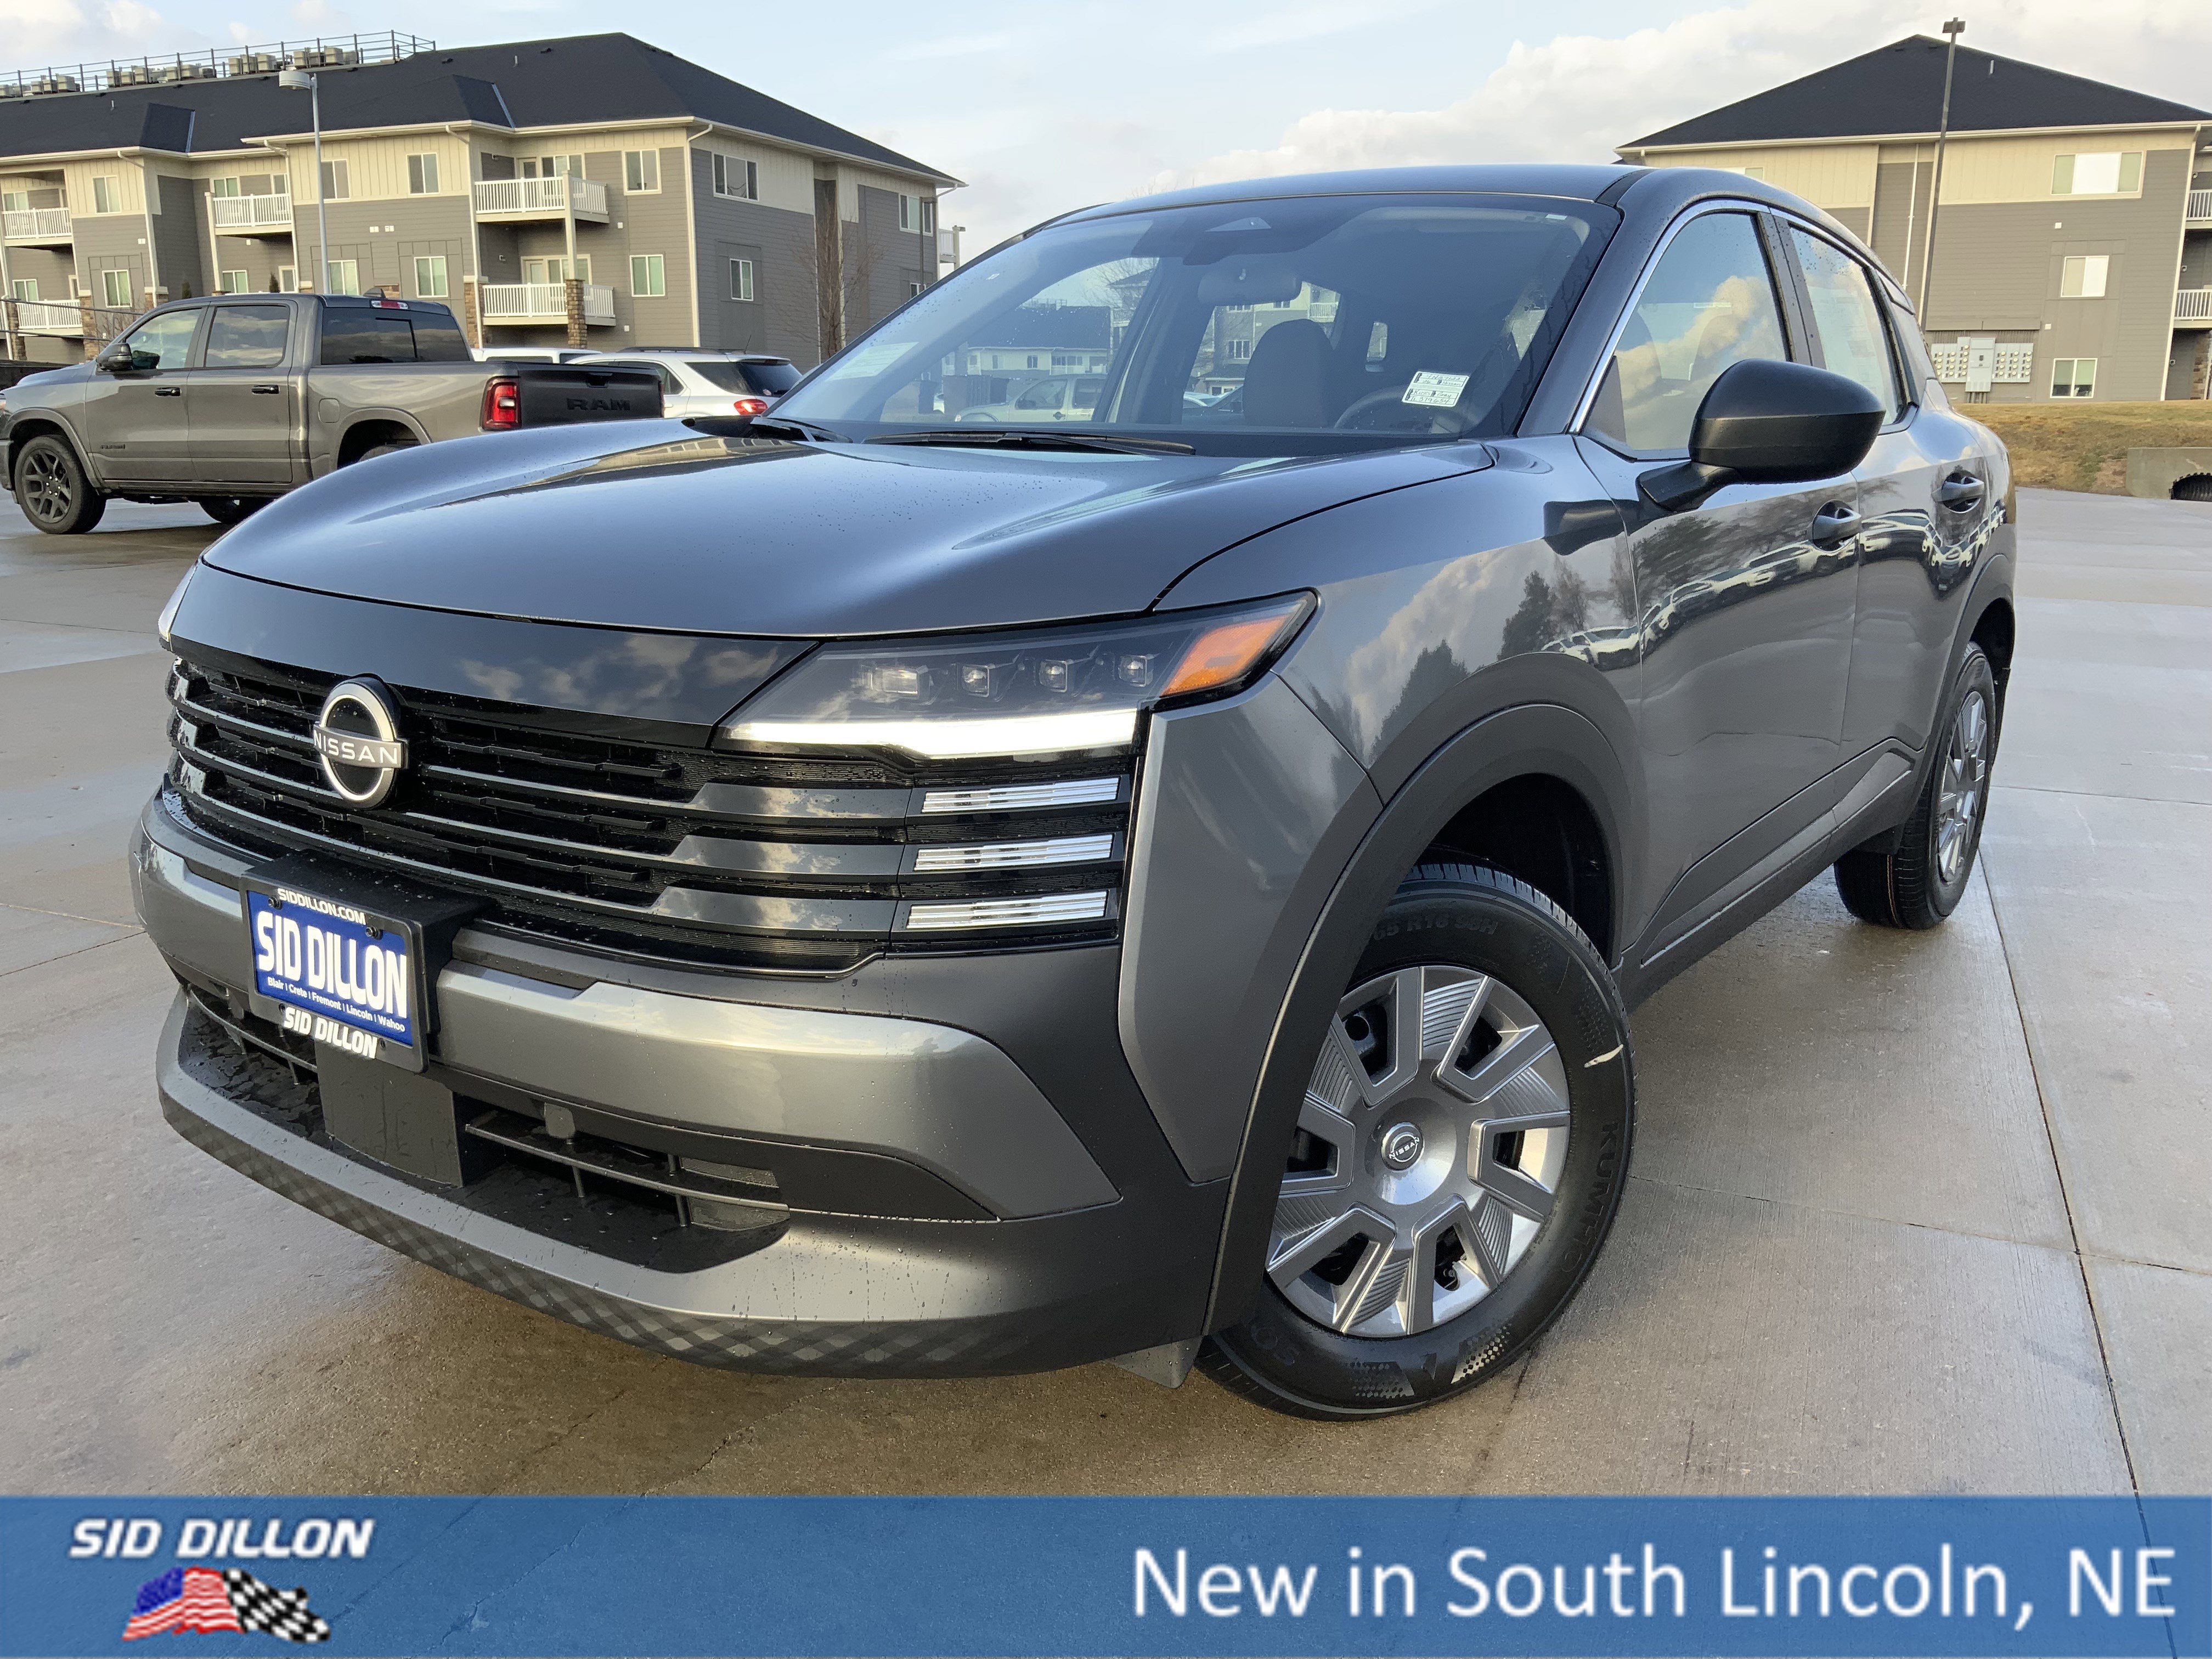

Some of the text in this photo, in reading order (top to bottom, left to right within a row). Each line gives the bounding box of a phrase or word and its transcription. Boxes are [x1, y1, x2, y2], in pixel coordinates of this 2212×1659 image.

[567, 398, 630, 410] RAM
[314, 730, 398, 764] NISSAN
[277, 888, 366, 926] SIDDILLON.COM
[257, 911, 407, 1019] SID DILLON
[267, 977, 405, 1032] Blair Crete Fremont Lincoln Wahoo
[283, 1006, 378, 1059] SID DILLON
[1389, 1137, 1420, 1159] NISSAN
